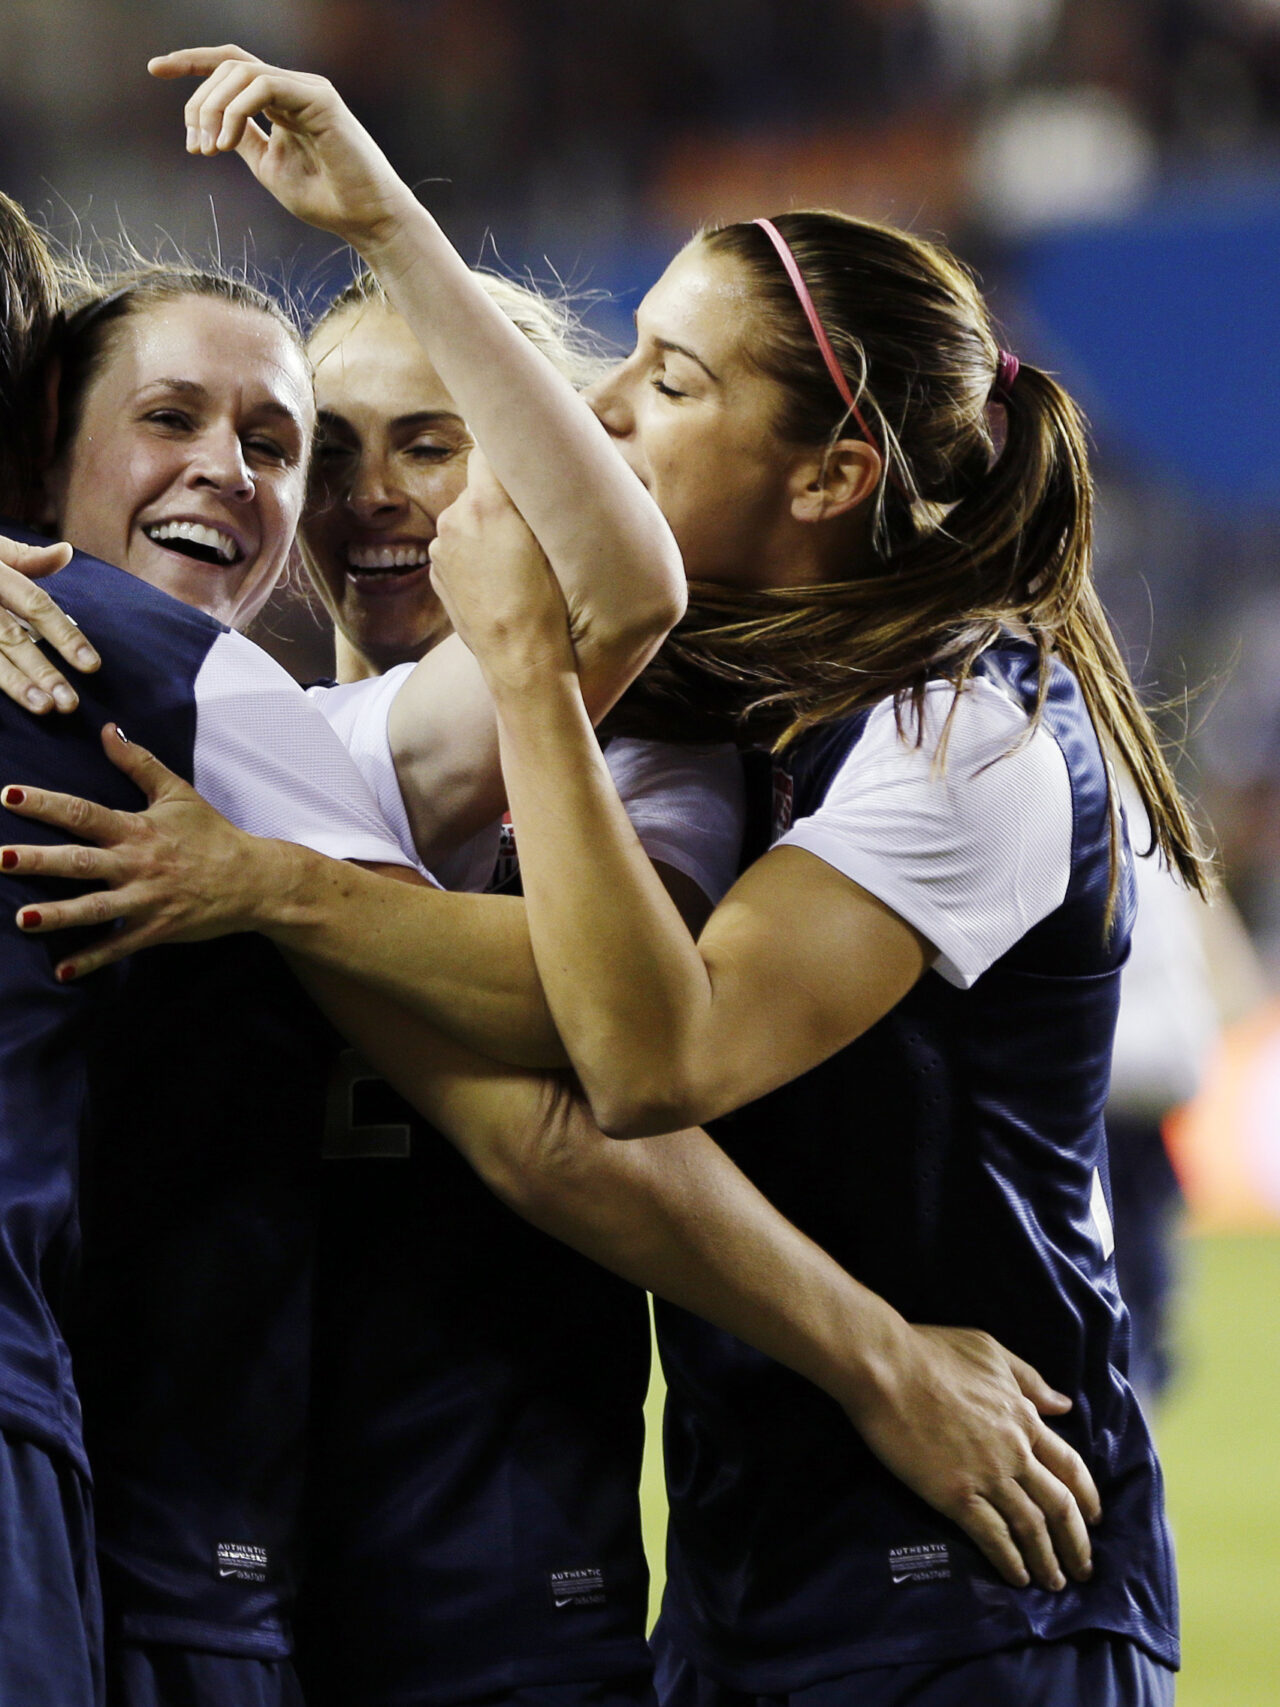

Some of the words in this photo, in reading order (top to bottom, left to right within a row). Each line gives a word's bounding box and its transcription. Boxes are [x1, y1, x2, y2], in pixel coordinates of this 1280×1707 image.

[218, 1543, 267, 1555] AUTHENTIC
[889, 1544, 947, 1556] AUTHENTIC
[551, 1568, 602, 1580] AUTHENTIC
